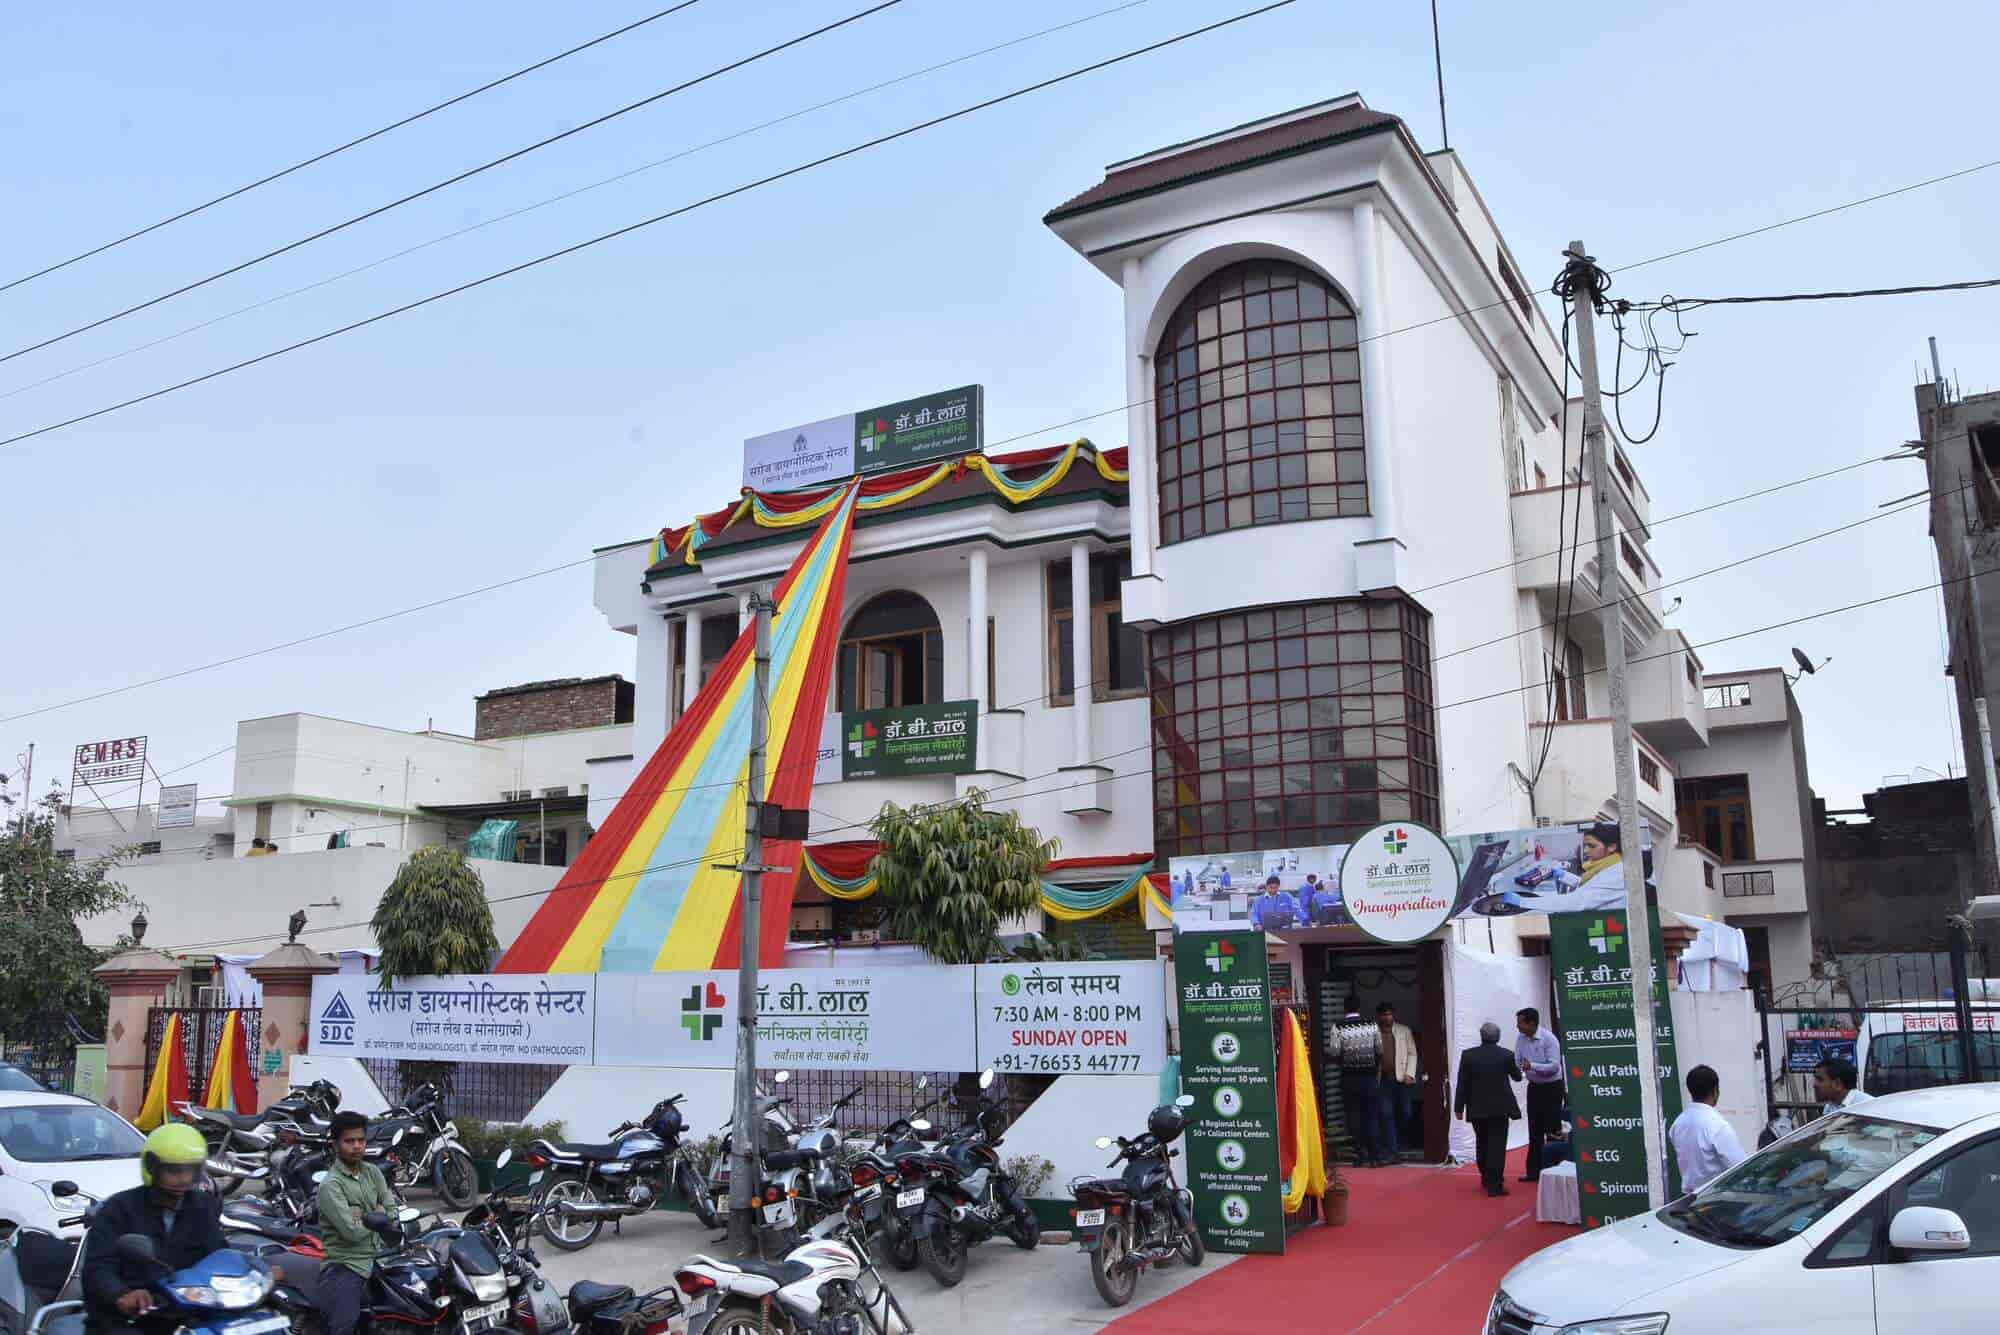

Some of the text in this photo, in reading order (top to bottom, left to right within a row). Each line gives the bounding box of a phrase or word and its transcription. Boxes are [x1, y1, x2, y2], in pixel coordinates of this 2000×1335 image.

[937, 402, 967, 420] लाल
[884, 717, 967, 738] डॉ. बी. लाल
[80, 738, 136, 765] CMRS
[1404, 863, 1430, 874] लाल
[1353, 896, 1448, 917] Inauguration
[1024, 967, 1120, 996] लैब समय
[1564, 966, 1589, 985] डॉ.
[1591, 964, 1617, 982] बी.
[779, 982, 812, 1012] बी.
[817, 991, 870, 1012] लाल
[1184, 982, 1262, 998] डॉ. बी. लाल
[417, 981, 530, 1016] डायग्नोस्टिक
[534, 980, 586, 1016] सेन्टर
[994, 1006, 1028, 1022] 7:30
[1033, 1006, 1058, 1022] AM
[1073, 1006, 1109, 1022] 8:00
[1115, 1006, 1141, 1021] PM
[320, 1025, 354, 1040] SDC
[463, 1023, 473, 1034] व
[1566, 1027, 1672, 1041] SERVICES AVALE
[1012, 1029, 1127, 1046] SUNDAY OPEN
[993, 1055, 1141, 1070] +91-76653 44777
[1589, 1064, 1672, 1079] All Pathgy
[1589, 1084, 1623, 1097] Tests
[1207, 1129, 1241, 1137] Collection
[1594, 1150, 1620, 1162] ECG
[1230, 1229, 1265, 1238] Collection
[1223, 1239, 1250, 1248] Facility
